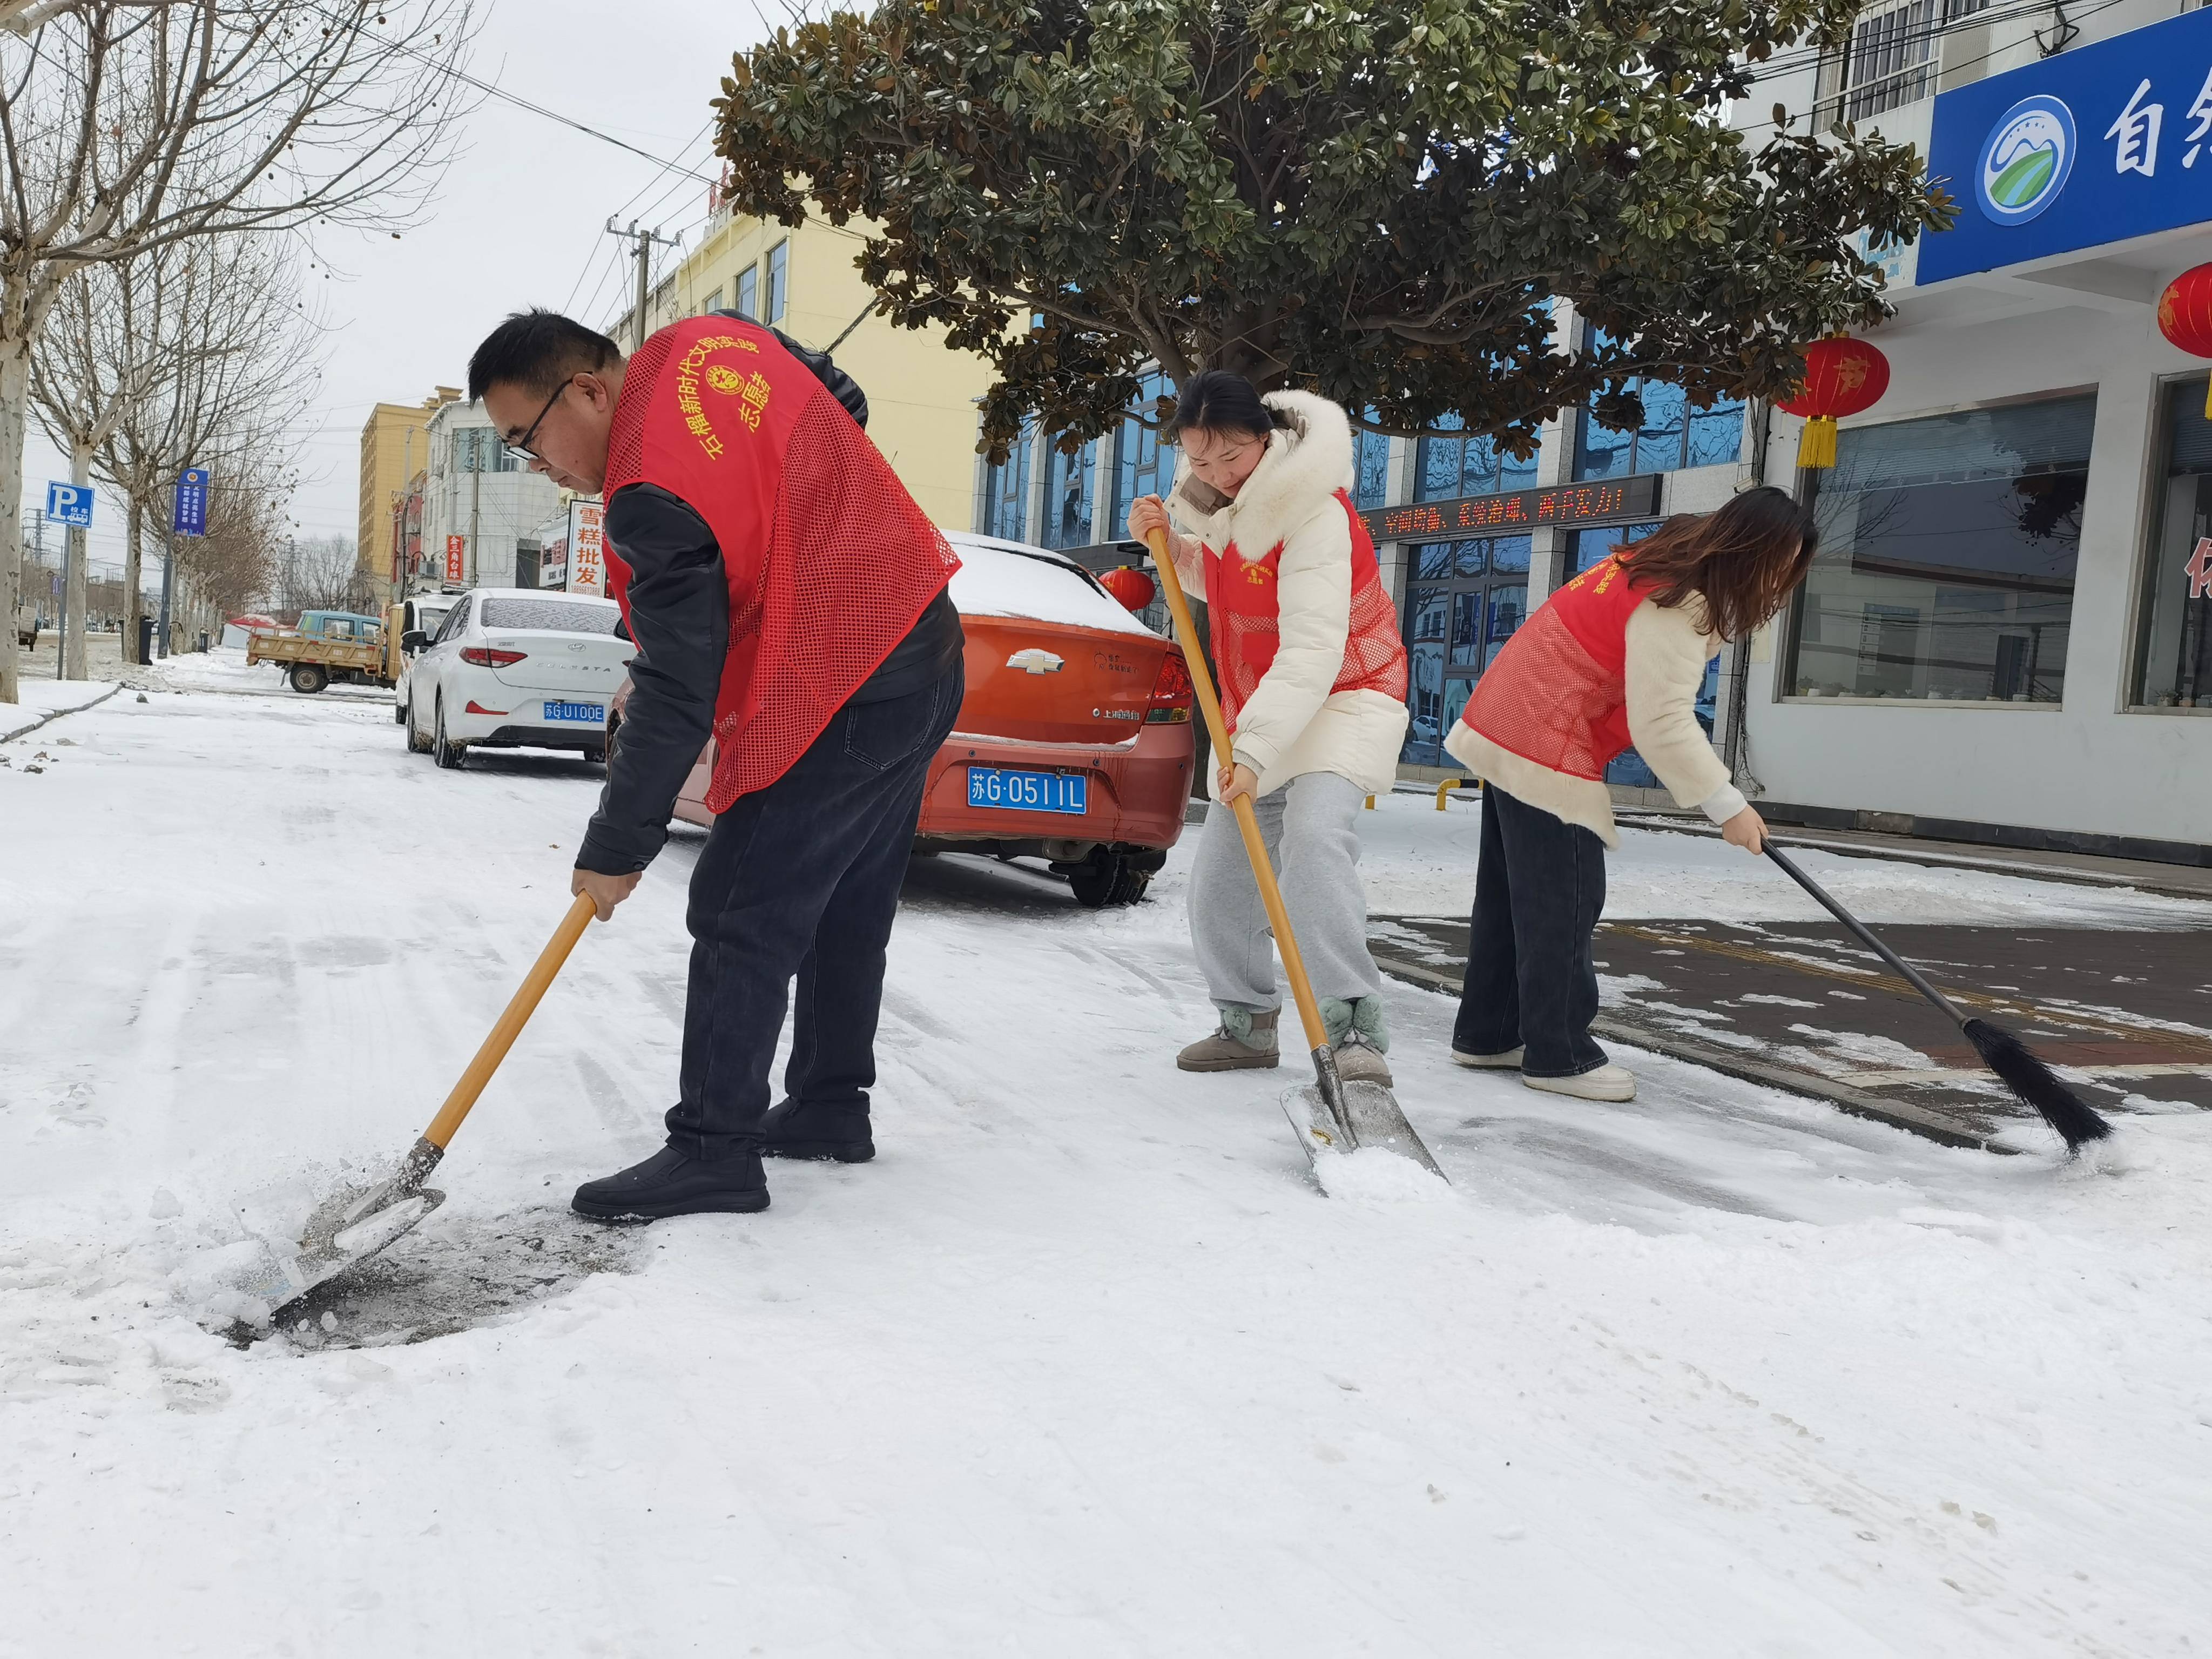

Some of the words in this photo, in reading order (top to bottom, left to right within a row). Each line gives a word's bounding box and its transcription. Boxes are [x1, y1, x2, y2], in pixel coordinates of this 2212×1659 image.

[676, 336, 760, 461] 石榴新时代文明实践
[738, 370, 772, 433] 志愿者
[50, 485, 78, 520] P
[575, 507, 602, 585] 雪糕批发
[536, 662, 611, 672] CELESTA
[1103, 709, 1139, 720] 上海通用
